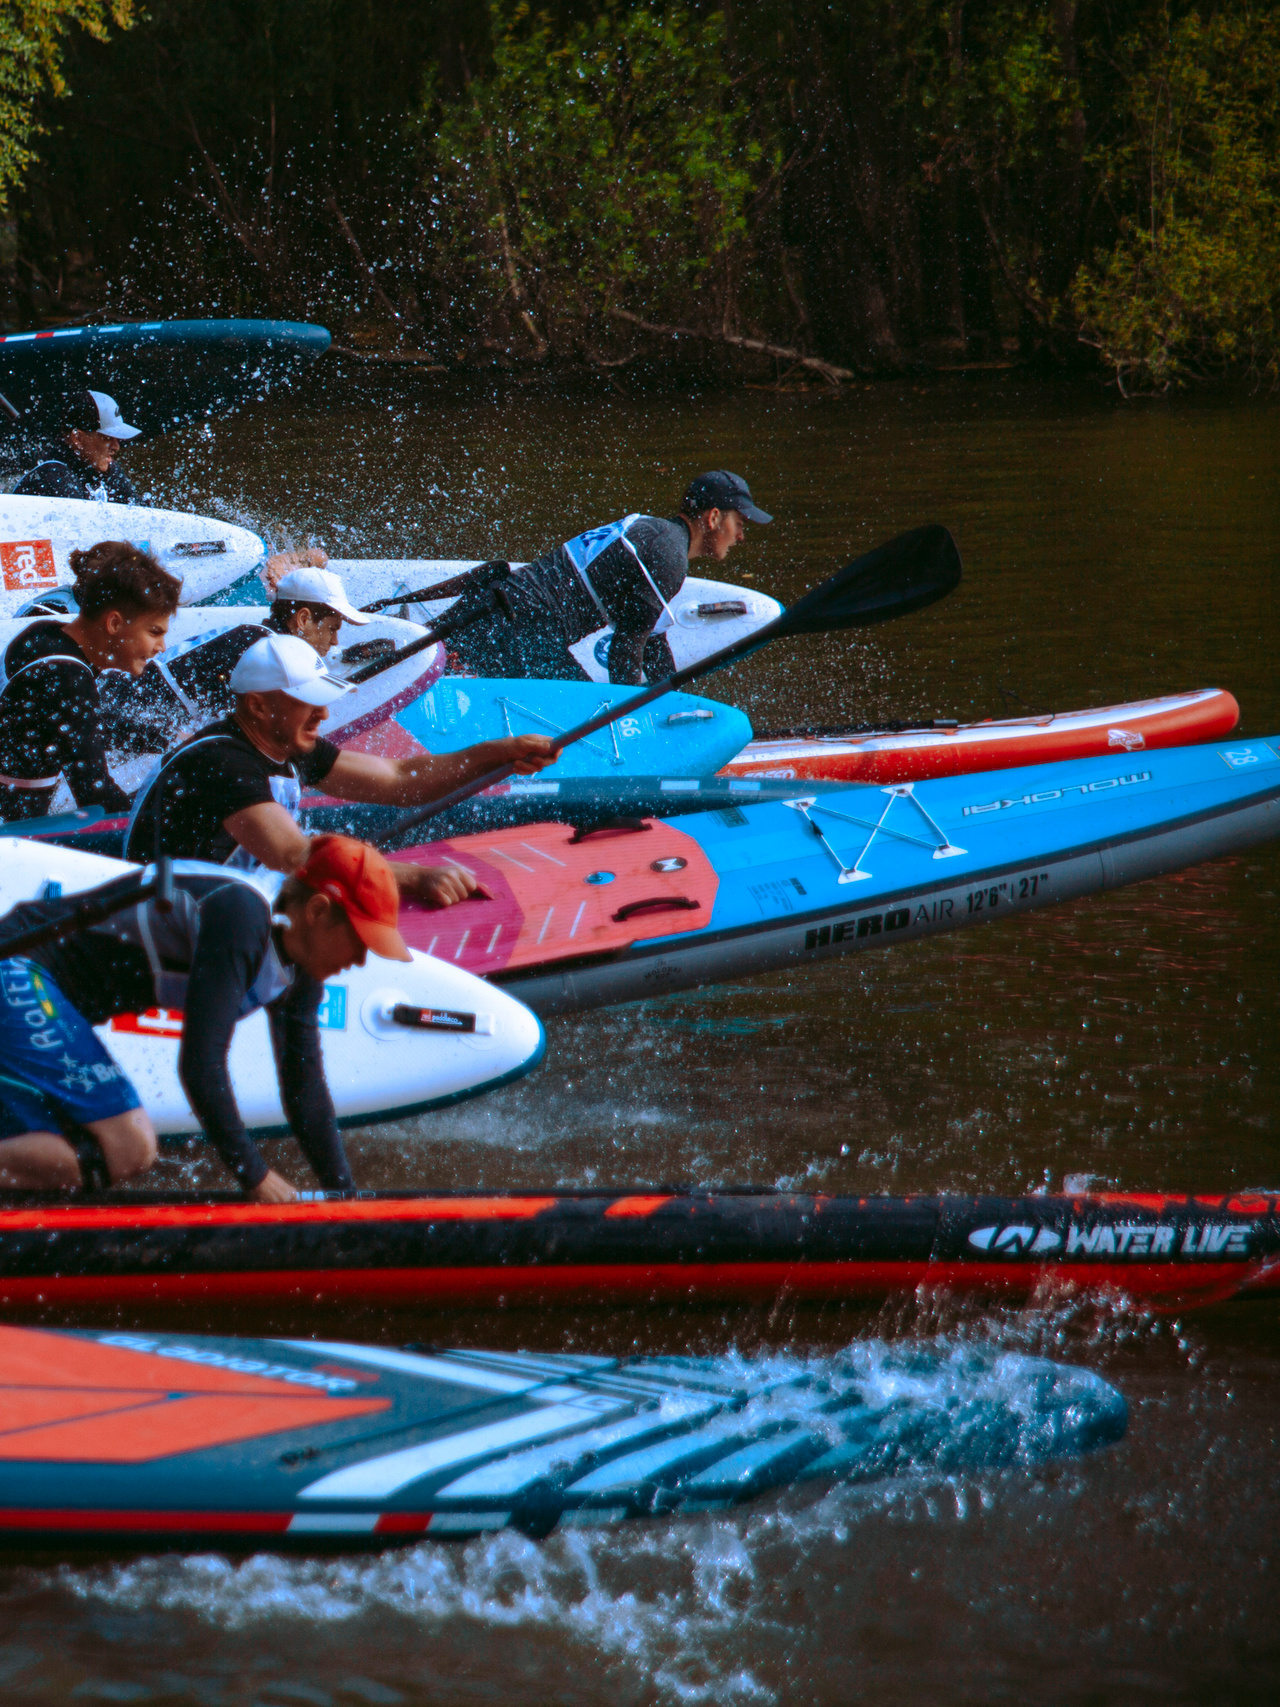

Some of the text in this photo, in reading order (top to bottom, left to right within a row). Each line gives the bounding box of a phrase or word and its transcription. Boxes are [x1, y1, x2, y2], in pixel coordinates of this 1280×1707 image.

[15, 545, 58, 584] red
[620, 718, 641, 737] 66
[1224, 747, 1259, 766] 28
[962, 771, 1151, 816] MOLOKAI
[805, 908, 910, 950] HERO
[913, 898, 954, 926] AIR
[1066, 1225, 1251, 1254] WATER LIVE
